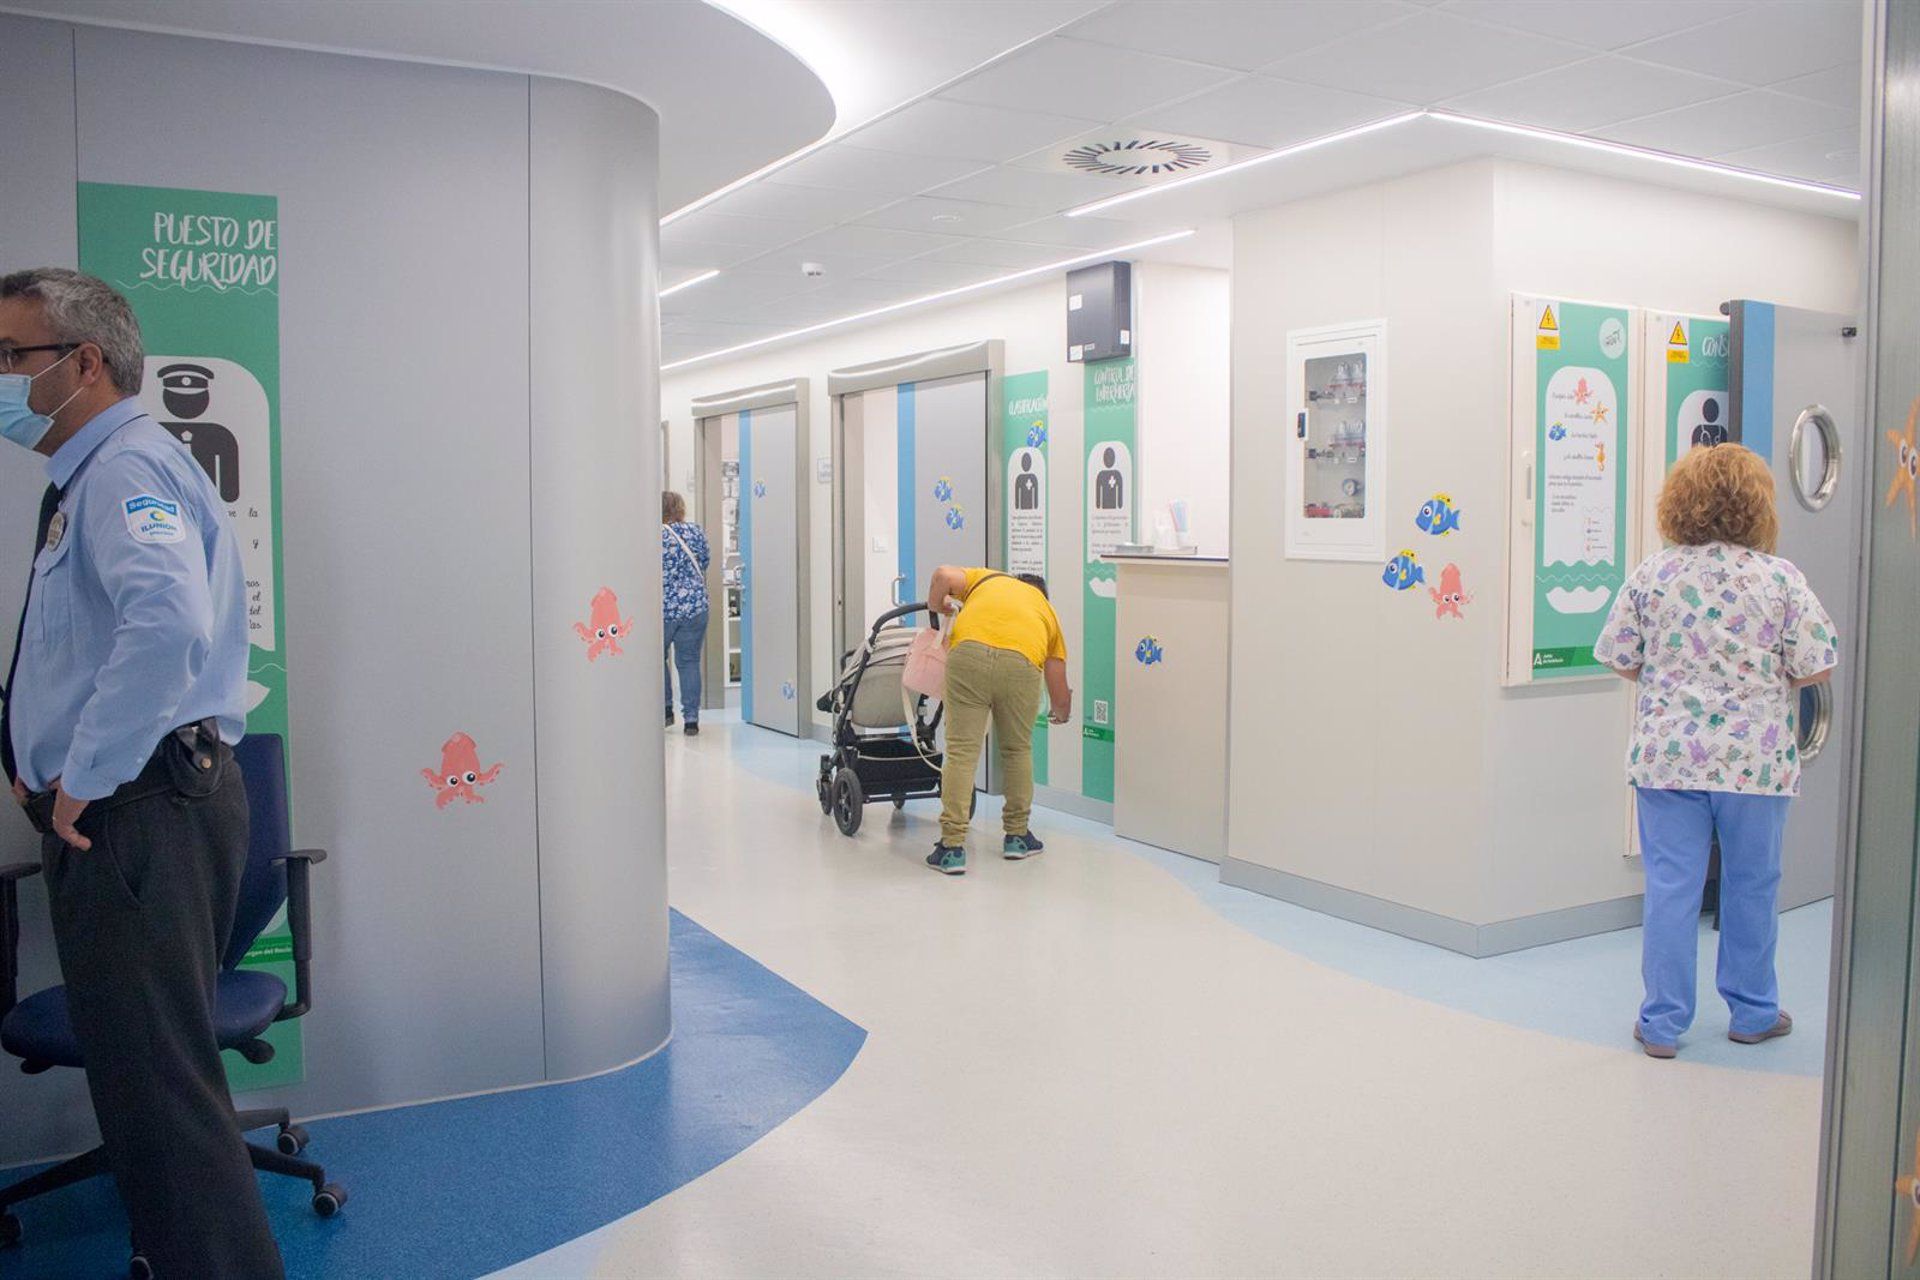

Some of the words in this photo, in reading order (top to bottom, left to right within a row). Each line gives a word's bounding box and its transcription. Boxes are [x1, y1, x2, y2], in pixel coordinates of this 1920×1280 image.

[154, 212, 240, 248] PUESTO
[244, 219, 277, 250] DE
[140, 247, 277, 290] SEGURIDAD
